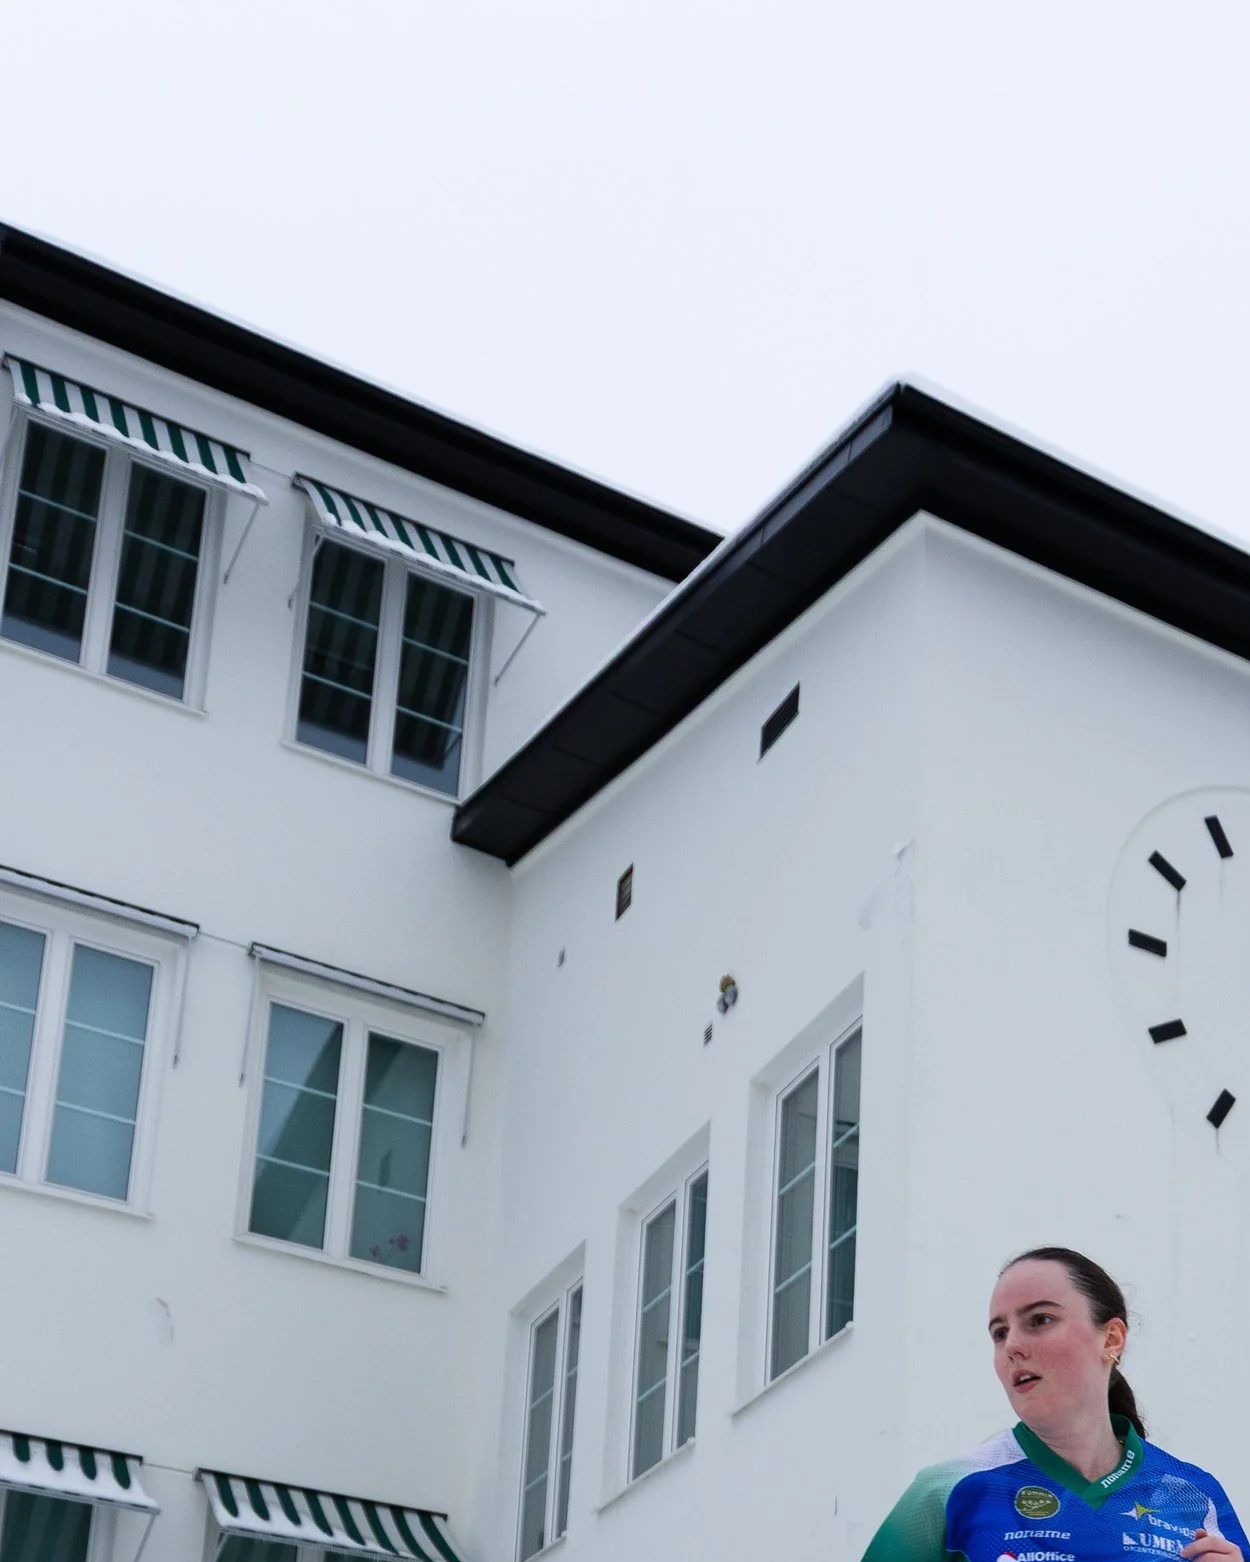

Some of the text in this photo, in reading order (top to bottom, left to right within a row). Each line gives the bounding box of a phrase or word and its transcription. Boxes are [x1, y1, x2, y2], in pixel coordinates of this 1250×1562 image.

[1101, 1450, 1135, 1488] noname
[1003, 1529, 1071, 1541] noname
[1017, 1551, 1075, 1562] AllOffice
